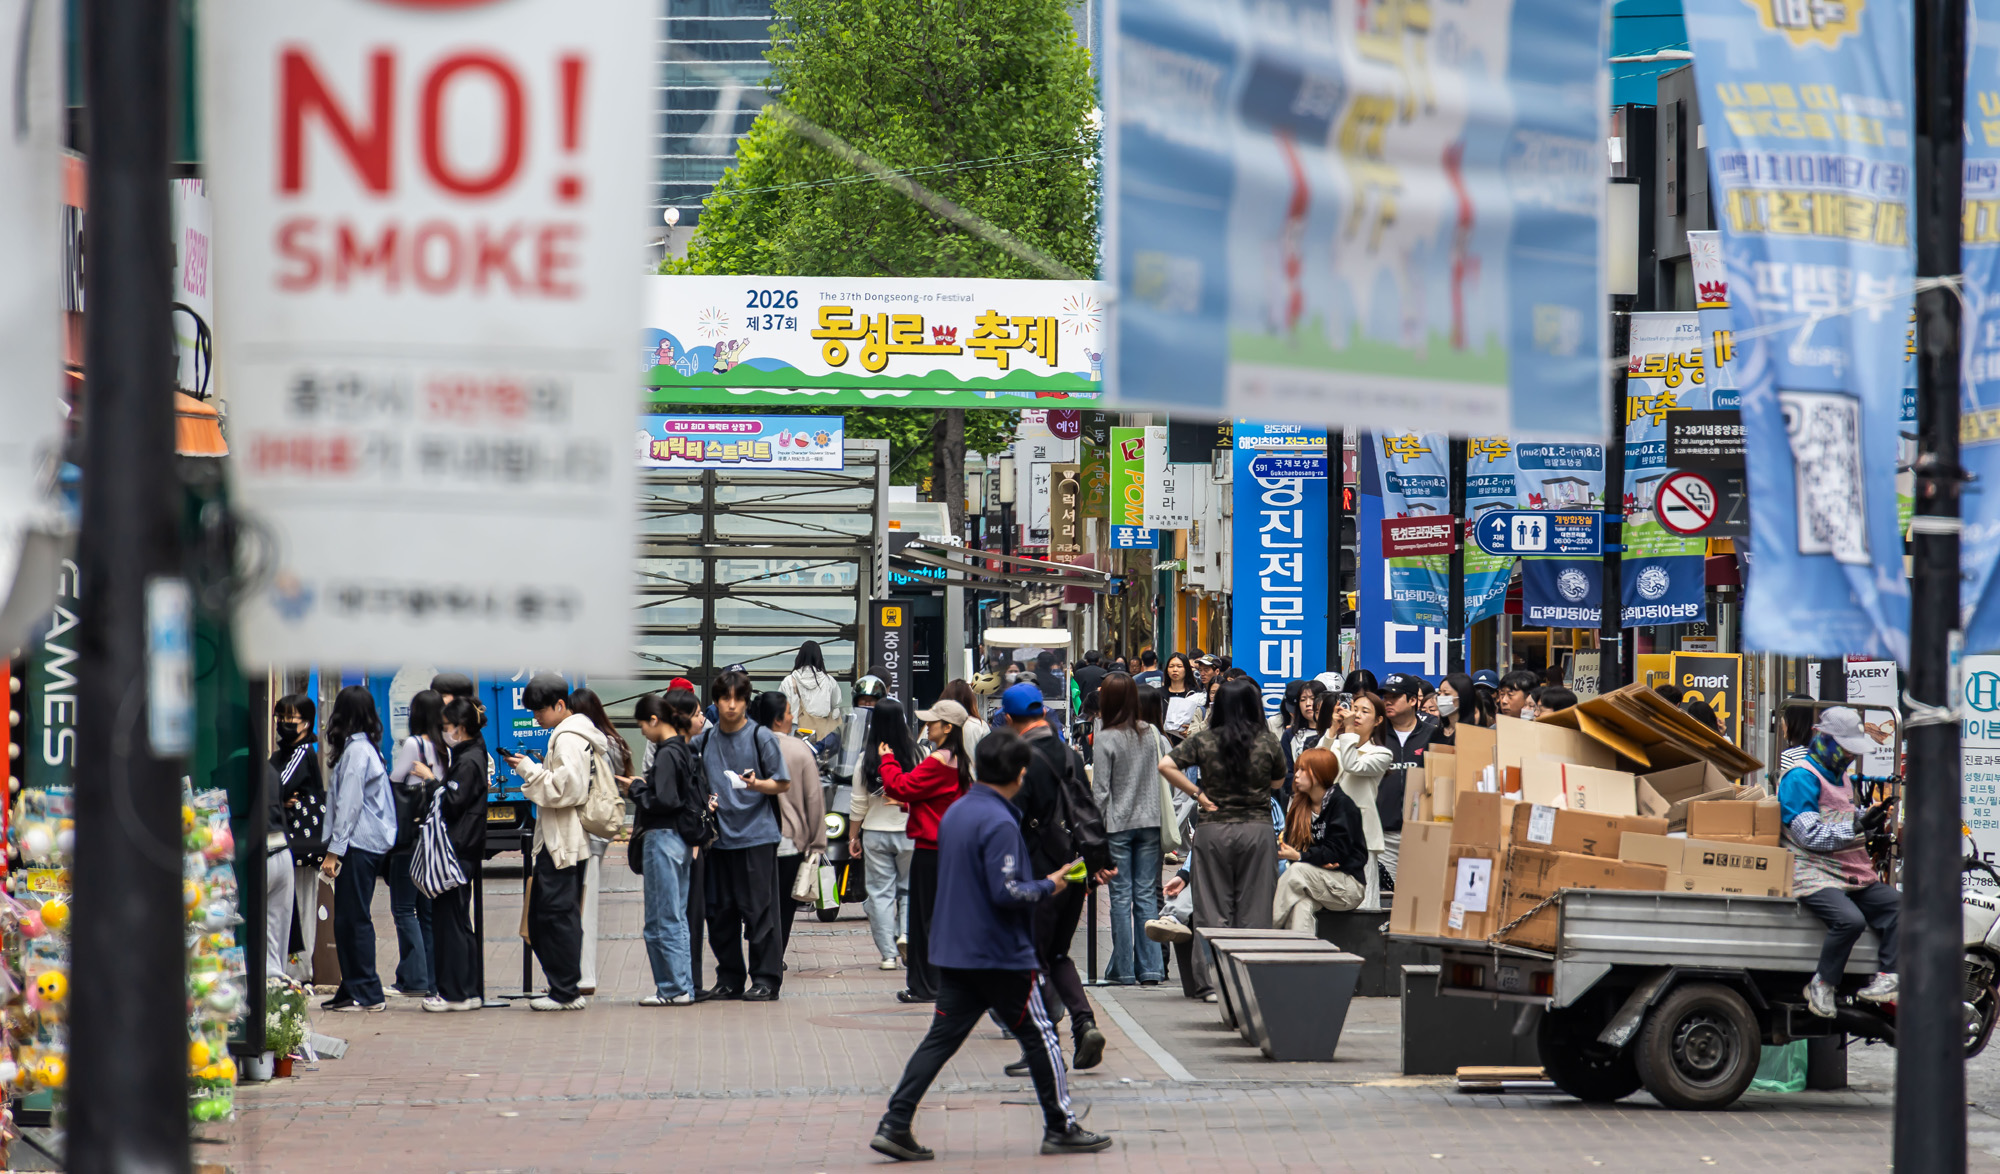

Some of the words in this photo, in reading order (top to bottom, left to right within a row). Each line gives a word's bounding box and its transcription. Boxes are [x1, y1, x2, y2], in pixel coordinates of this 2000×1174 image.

[277, 45, 590, 201] NO!
[274, 218, 584, 297] SMOKE
[746, 289, 799, 309] 2026
[819, 291, 837, 301] The
[839, 291, 862, 301] 37th
[864, 292, 934, 304] Dongseong-ro
[936, 292, 975, 303] Festival
[810, 305, 964, 372] 동성로
[965, 309, 1060, 371] 축제
[1056, 421, 1078, 433] 예인
[652, 437, 704, 460] 캐릭터
[705, 441, 771, 461] 스트리트
[1255, 464, 1268, 472] 591
[1274, 459, 1320, 469] 국제보상로
[1062, 493, 1076, 538] 럭셔리
[1554, 515, 1593, 525] 개방화장실
[1390, 524, 1451, 541] 동성로관광특구
[43, 557, 80, 768] GAMES
[1683, 673, 1729, 688] emart
[512, 730, 534, 738] 주문전화
[1389, 761, 1418, 770] OND
[1969, 784, 1996, 794] 리프팅
[1973, 807, 1991, 817] 제모
[1961, 897, 1996, 911] AELIM
